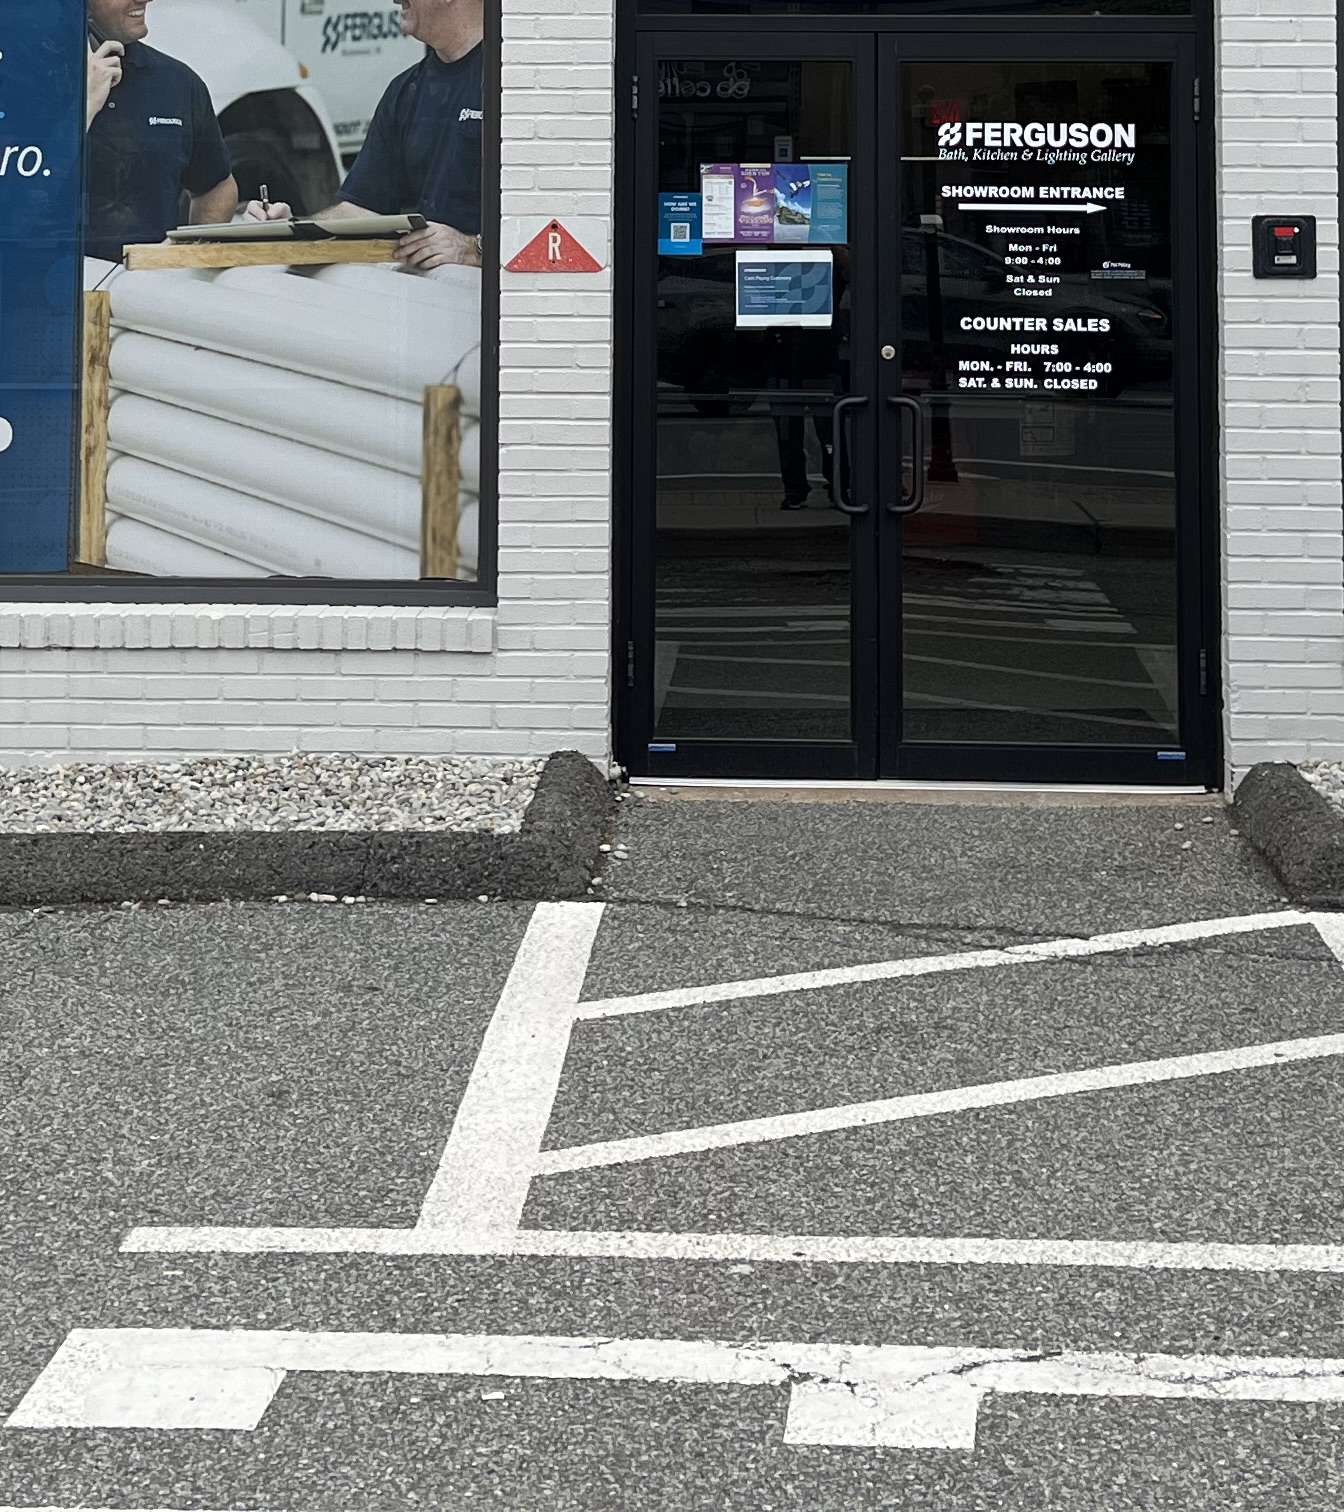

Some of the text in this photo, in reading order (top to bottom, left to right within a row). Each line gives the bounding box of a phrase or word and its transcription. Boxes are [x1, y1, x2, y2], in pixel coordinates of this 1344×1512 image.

[966, 123, 1135, 147] FERGUSON
[938, 149, 1135, 165] Bath, Kitchen & Lighting Gallery
[942, 186, 1124, 198] SHOWROOM ENTRANCE
[986, 225, 1080, 234] Showroom Hours
[548, 232, 561, 260] R
[1043, 244, 1057, 252] Fri
[1037, 257, 1061, 265] 4:00
[1038, 275, 1060, 283] Sun
[1014, 288, 1052, 296] Closed
[961, 317, 1110, 331] COUNTER SALES
[1011, 344, 1058, 354] HOURS
[959, 361, 994, 371] MON.
[1006, 361, 1031, 371] FRI.
[1044, 362, 1072, 372] 7:00
[1083, 363, 1111, 372] 4:00
[959, 377, 1097, 389] SAT. & SUN. CLOSED
